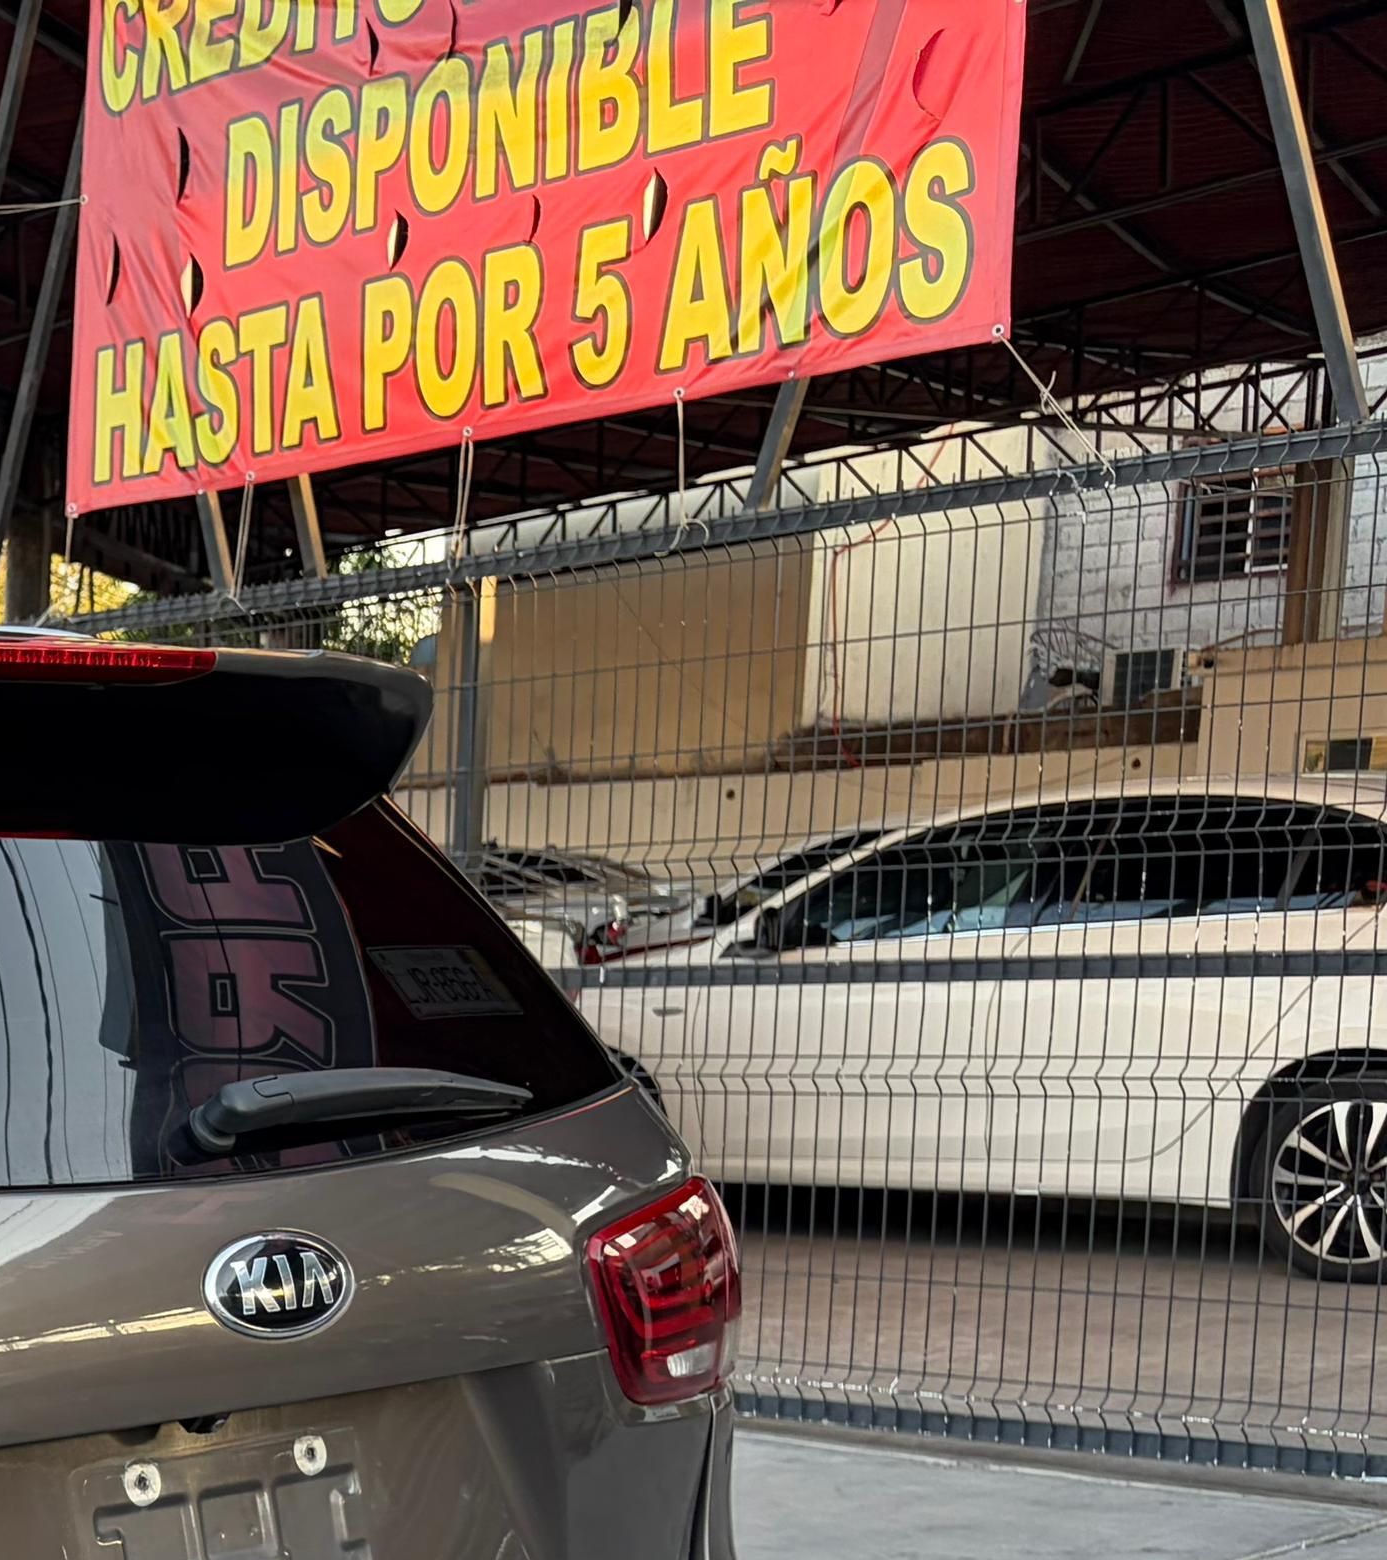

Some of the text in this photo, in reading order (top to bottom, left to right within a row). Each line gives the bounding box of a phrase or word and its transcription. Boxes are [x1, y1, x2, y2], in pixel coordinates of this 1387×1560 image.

[224, 0, 776, 270] DISPONIBLE
[91, 134, 976, 486] HASTA POR 5 AÑOS
[229, 1251, 334, 1316] KIA
